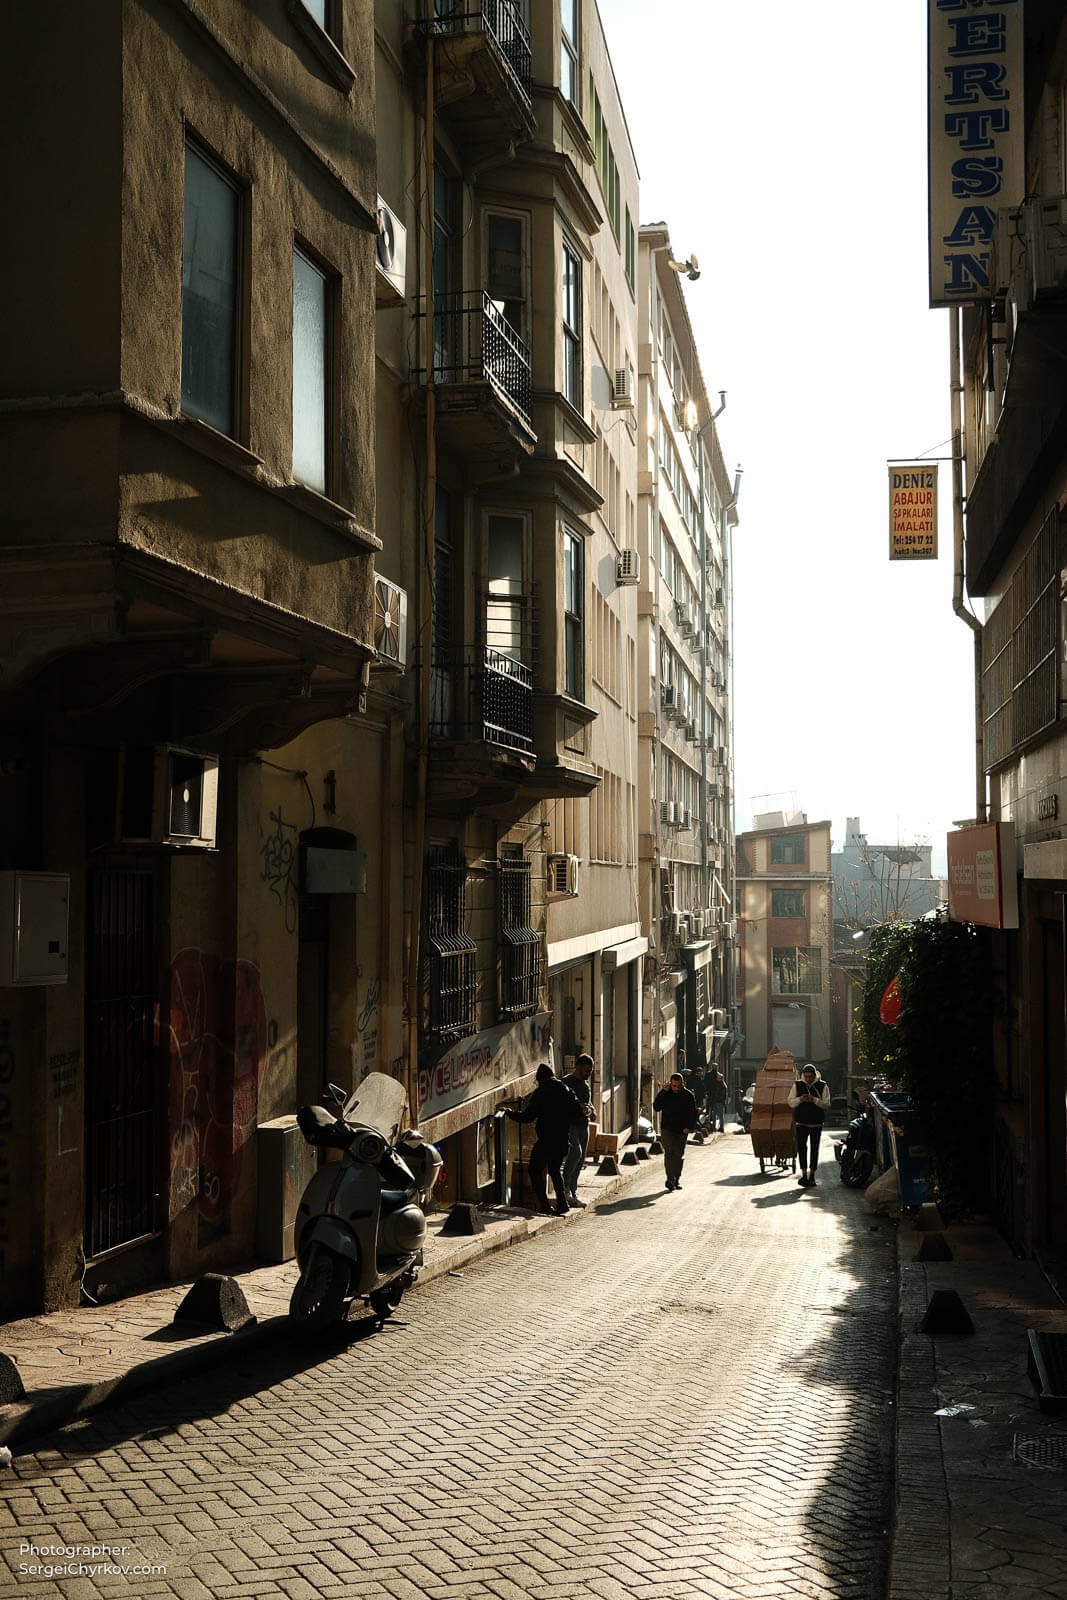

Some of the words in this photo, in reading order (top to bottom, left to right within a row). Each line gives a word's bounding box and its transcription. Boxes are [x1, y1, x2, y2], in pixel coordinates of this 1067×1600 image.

[937, 0, 1017, 294] ERTSAN
[893, 472, 933, 489] DENİZ
[893, 491, 933, 505] ABAJUR
